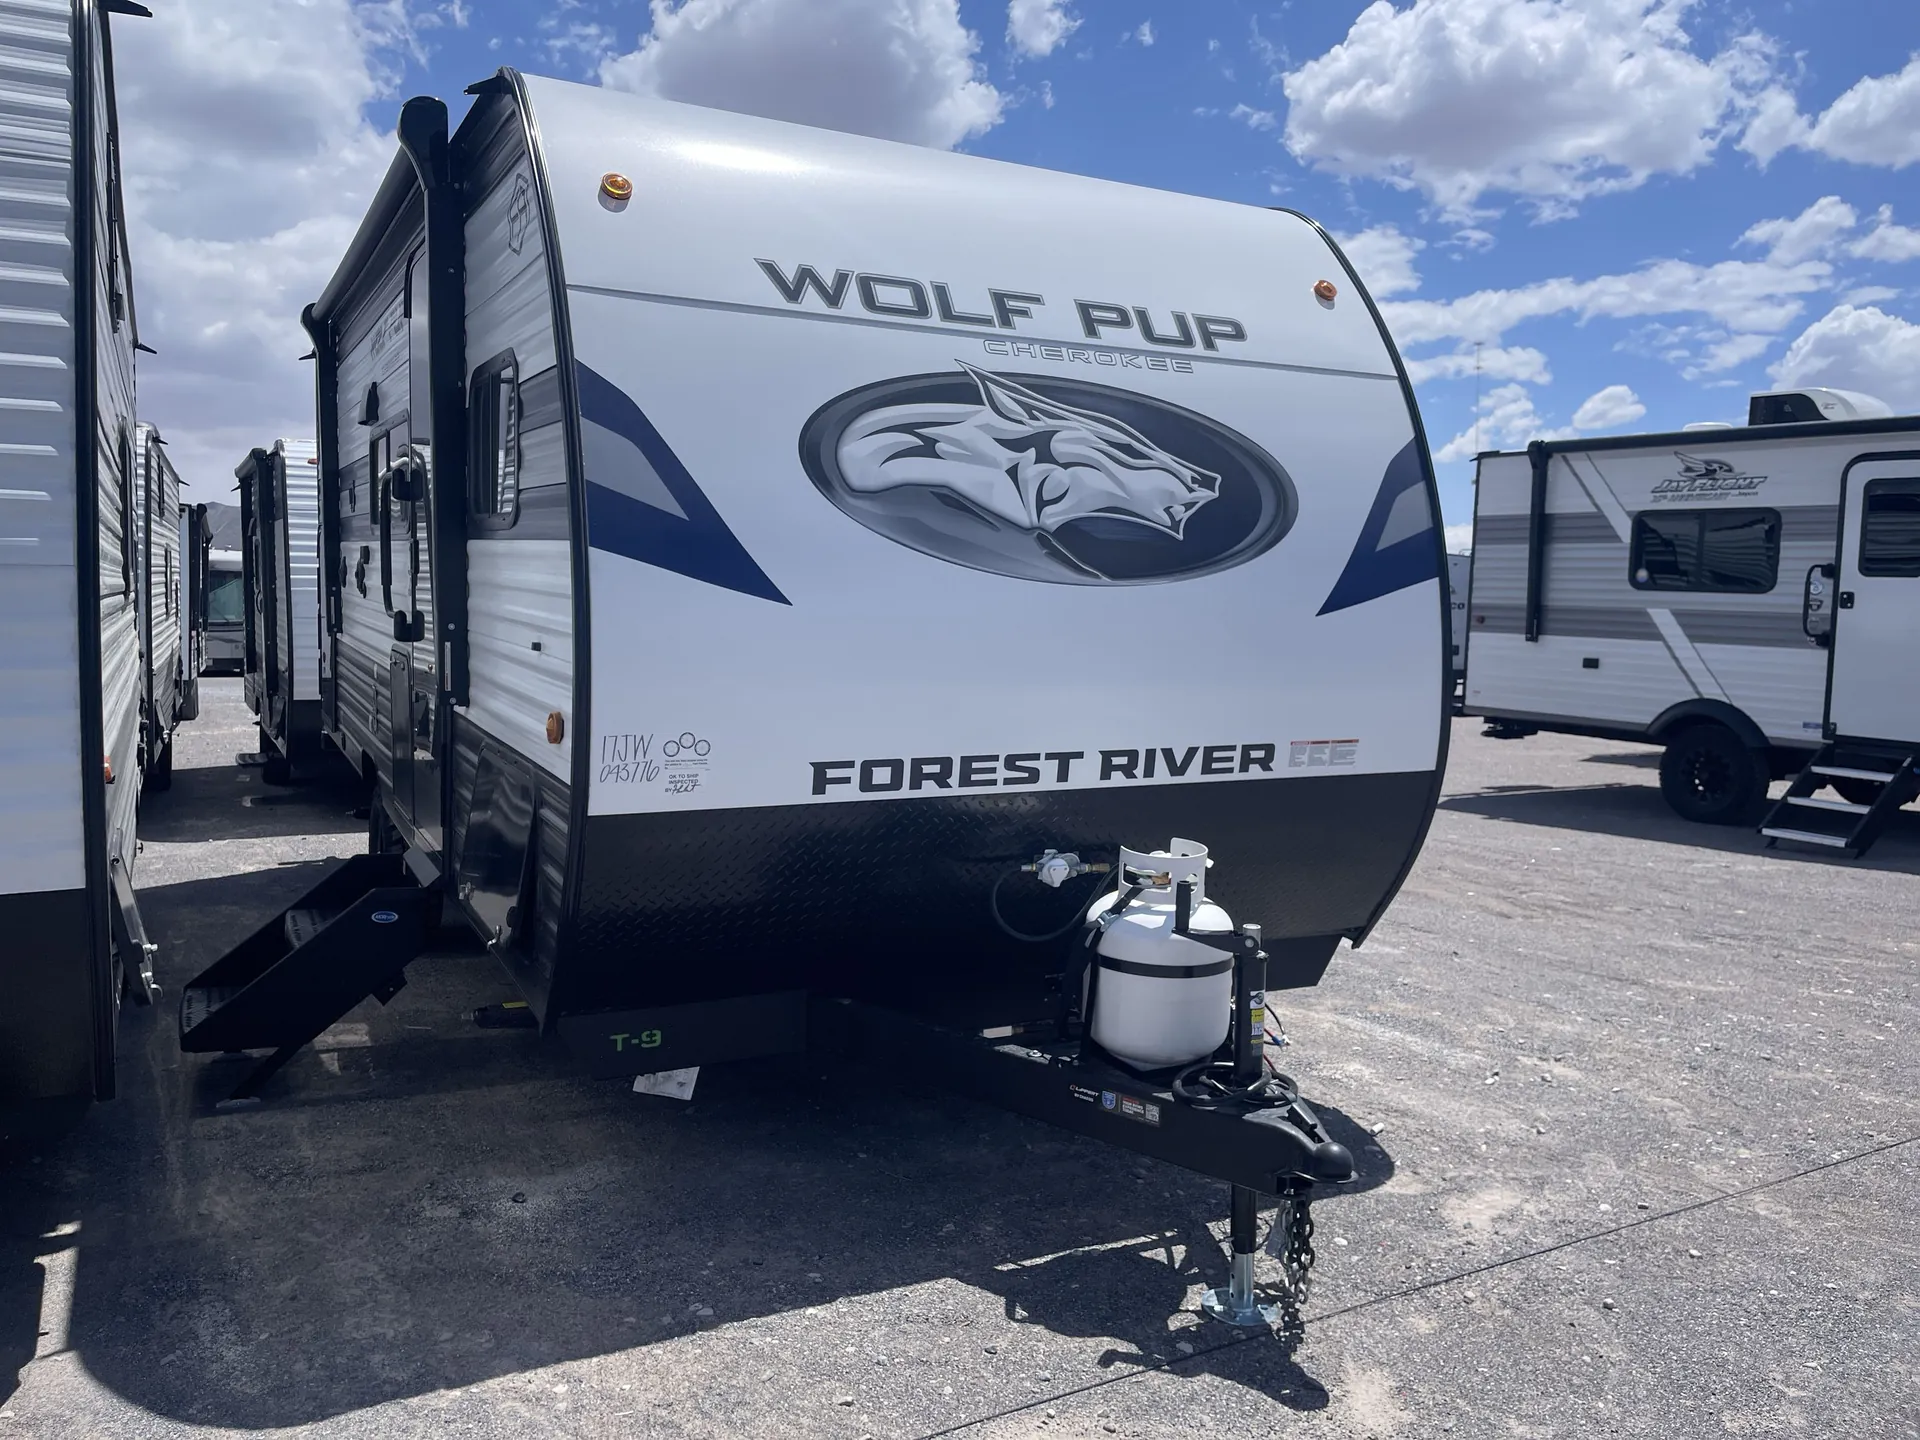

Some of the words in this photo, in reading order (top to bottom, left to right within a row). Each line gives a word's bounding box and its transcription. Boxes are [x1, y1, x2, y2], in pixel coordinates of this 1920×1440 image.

[754, 258, 1045, 330] WOLF
[1073, 299, 1247, 352] PUP
[983, 339, 1194, 374] CHEROKEE
[1651, 479, 1692, 493] JAY
[1689, 476, 1768, 491] FLIGHT
[602, 734, 653, 764] 17JW
[600, 759, 660, 783] 043776
[808, 751, 1085, 795] FOREST
[1098, 743, 1276, 781] RIVER
[609, 1030, 662, 1051] T-9
